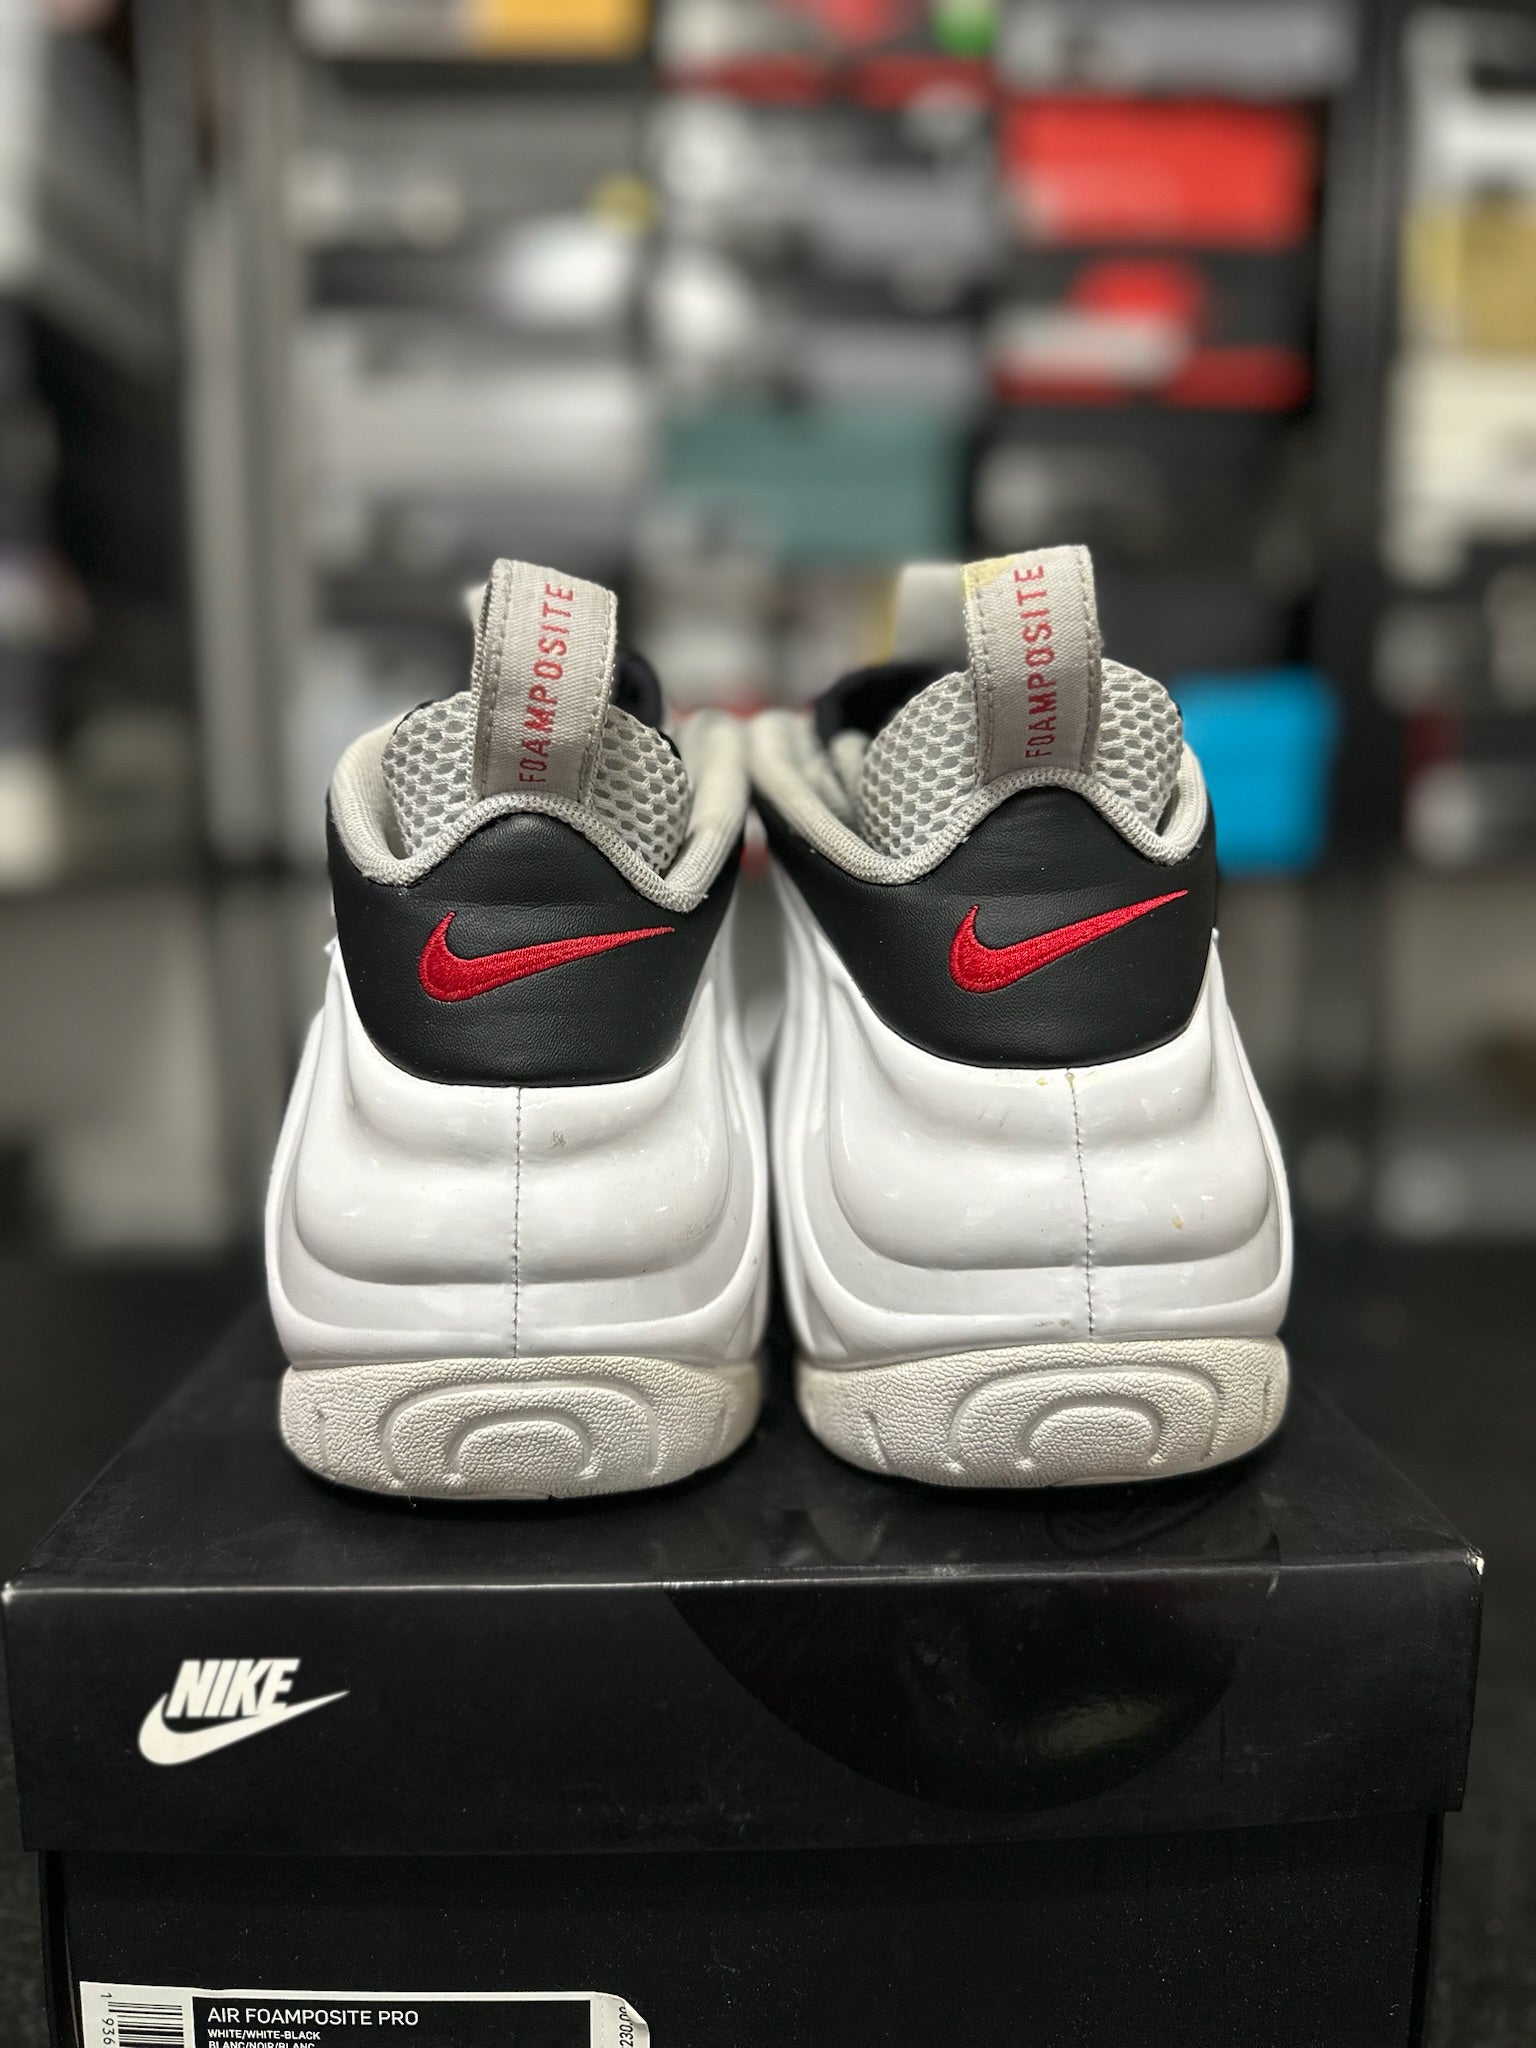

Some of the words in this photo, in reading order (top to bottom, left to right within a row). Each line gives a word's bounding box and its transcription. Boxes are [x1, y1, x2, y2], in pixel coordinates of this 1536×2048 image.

[519, 583, 575, 783] FOAMPOSITE
[1014, 565, 1057, 759] FOAMPOSITE
[164, 1658, 301, 1718] NIKE
[207, 2007, 240, 2024] AIR
[245, 2007, 373, 2026] FOAMPOSITE
[378, 2010, 419, 2026] PRO
[207, 2028, 321, 2041] WHITE/WHITE-BLACK
